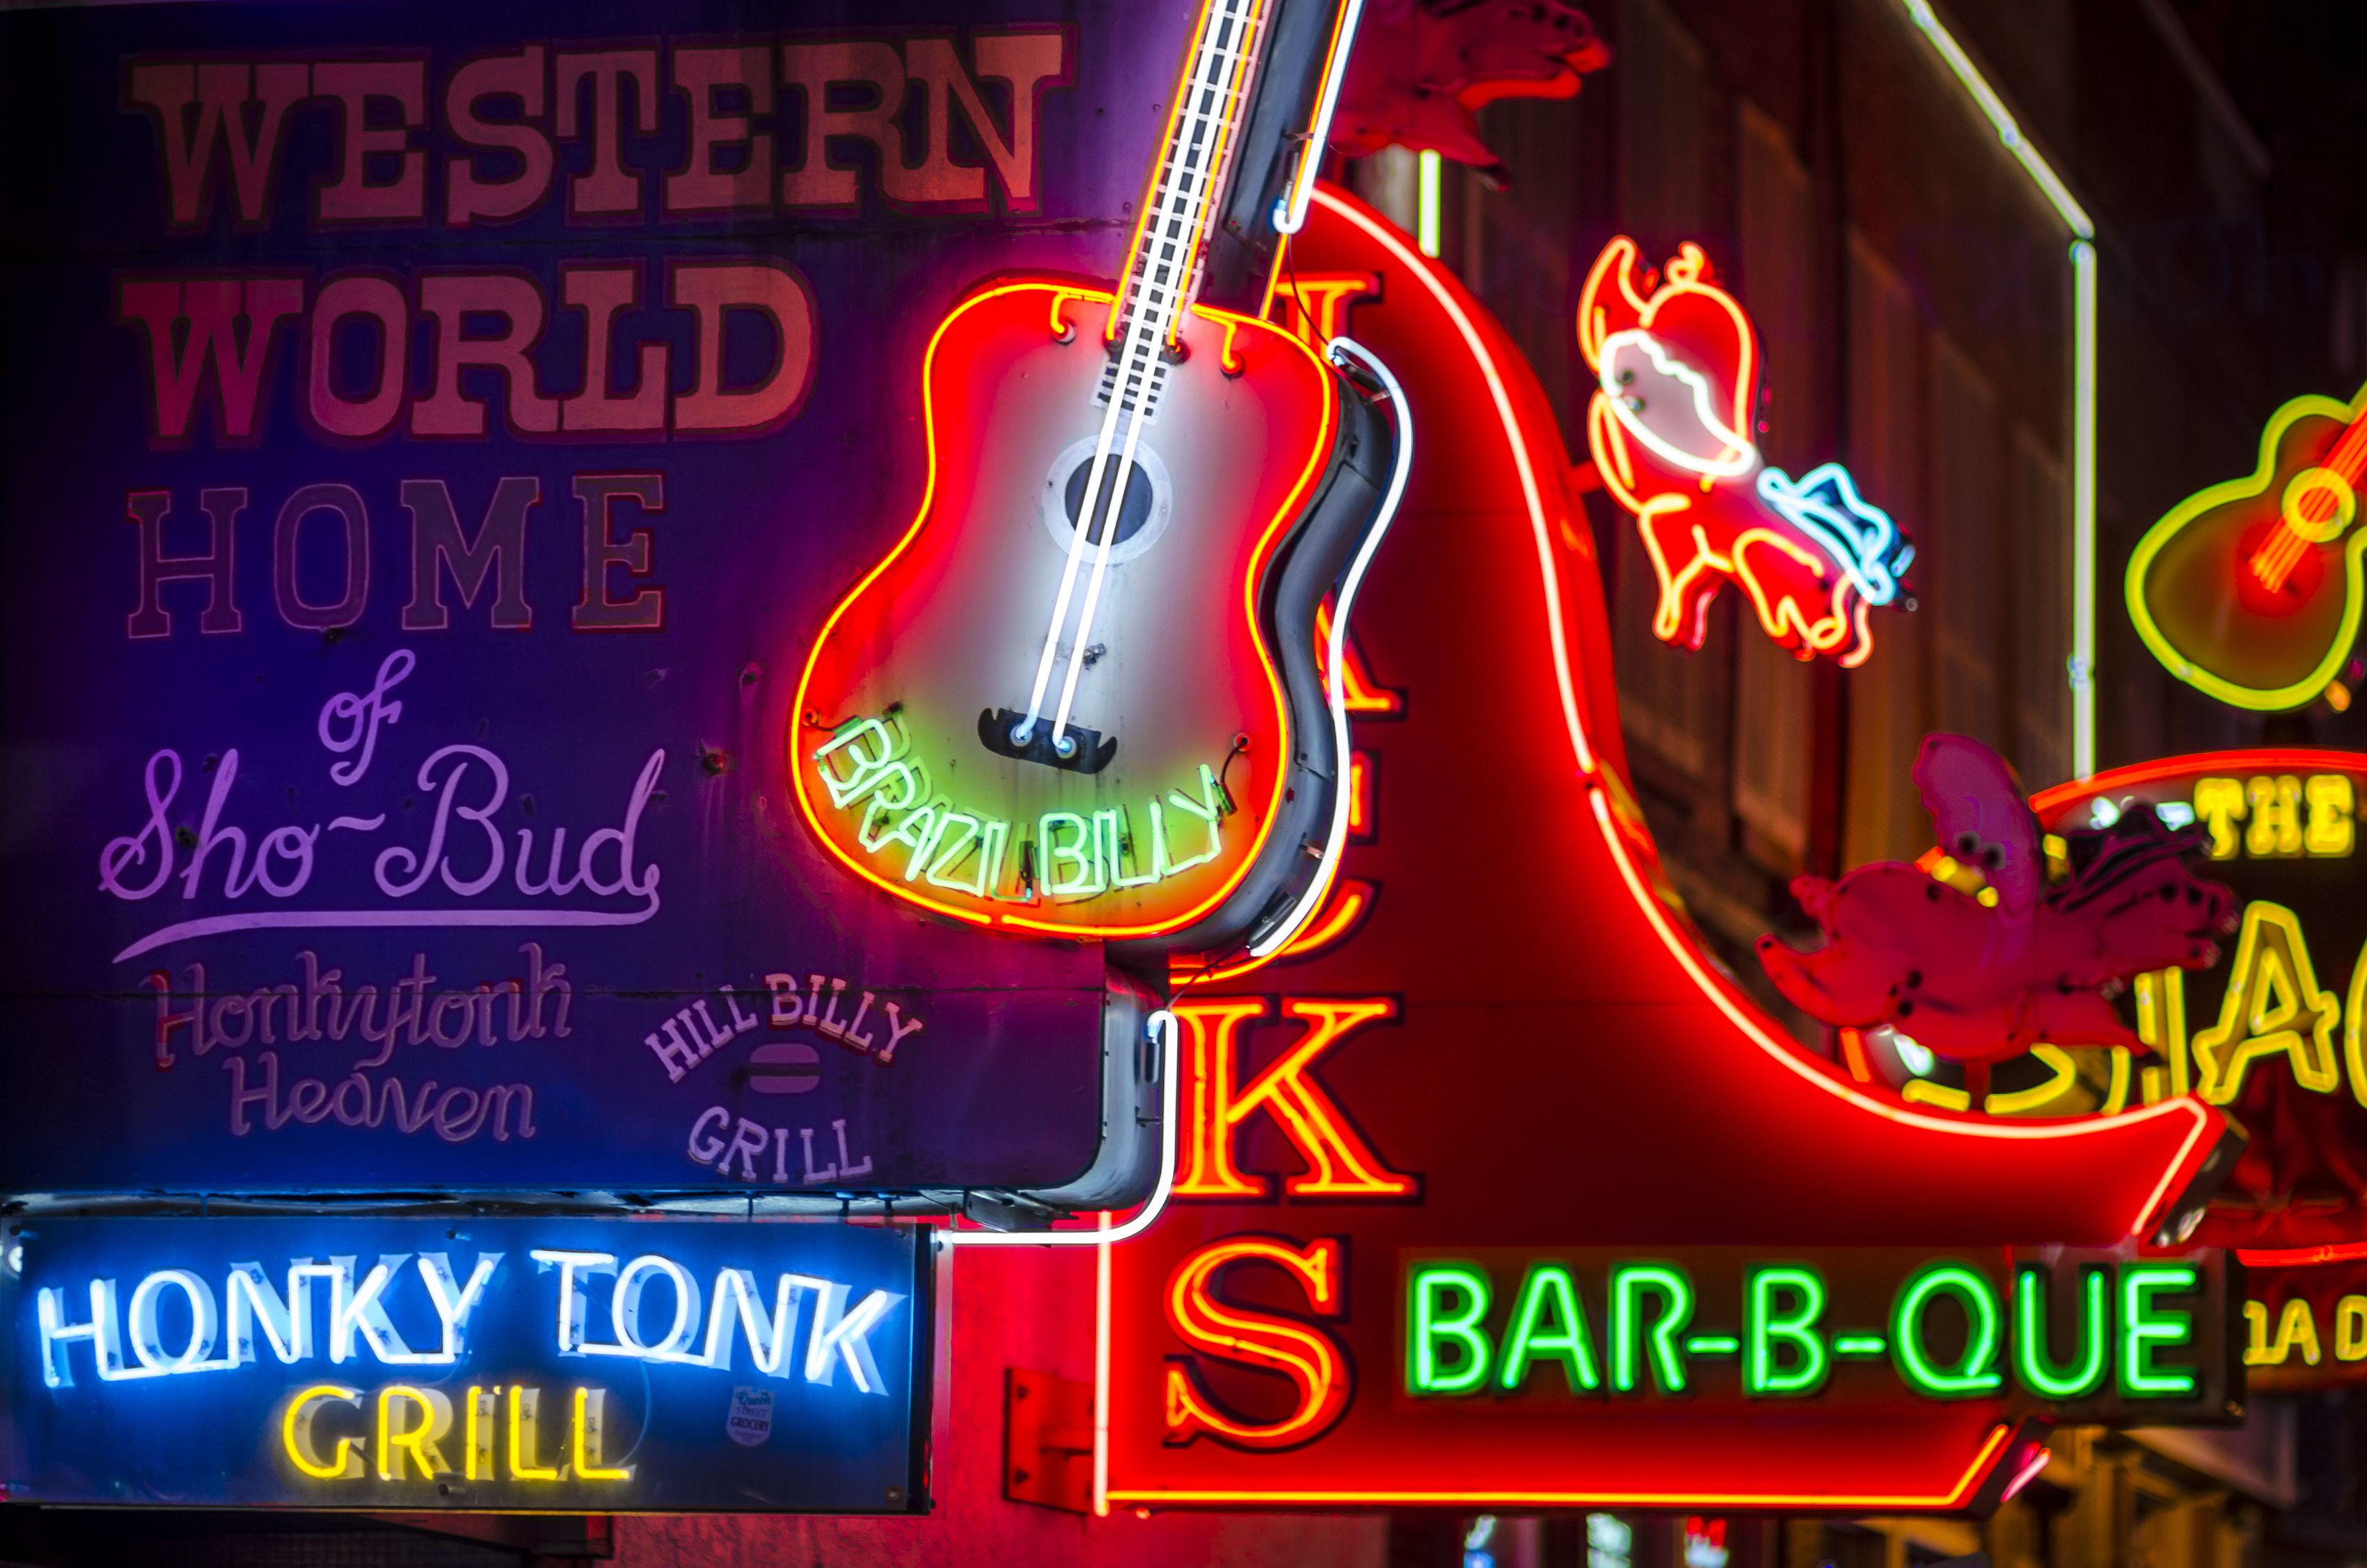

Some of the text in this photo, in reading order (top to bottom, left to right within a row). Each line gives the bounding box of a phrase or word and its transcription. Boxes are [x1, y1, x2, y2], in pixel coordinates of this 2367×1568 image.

[128, 30, 1067, 230] WESTERN
[121, 264, 818, 440] WORLD
[126, 472, 667, 640] HOME
[318, 648, 416, 785] of
[2193, 775, 2354, 858] THE
[138, 942, 572, 1070] Honkytonk
[644, 973, 923, 1084] HILL BILLY
[222, 1051, 535, 1142] Heaven
[687, 1106, 873, 1185] GRILL
[37, 1250, 907, 1397] HONKY TONK
[1409, 1264, 2198, 1394] BAR-B-QUE
[283, 1384, 637, 1481] GRILL
